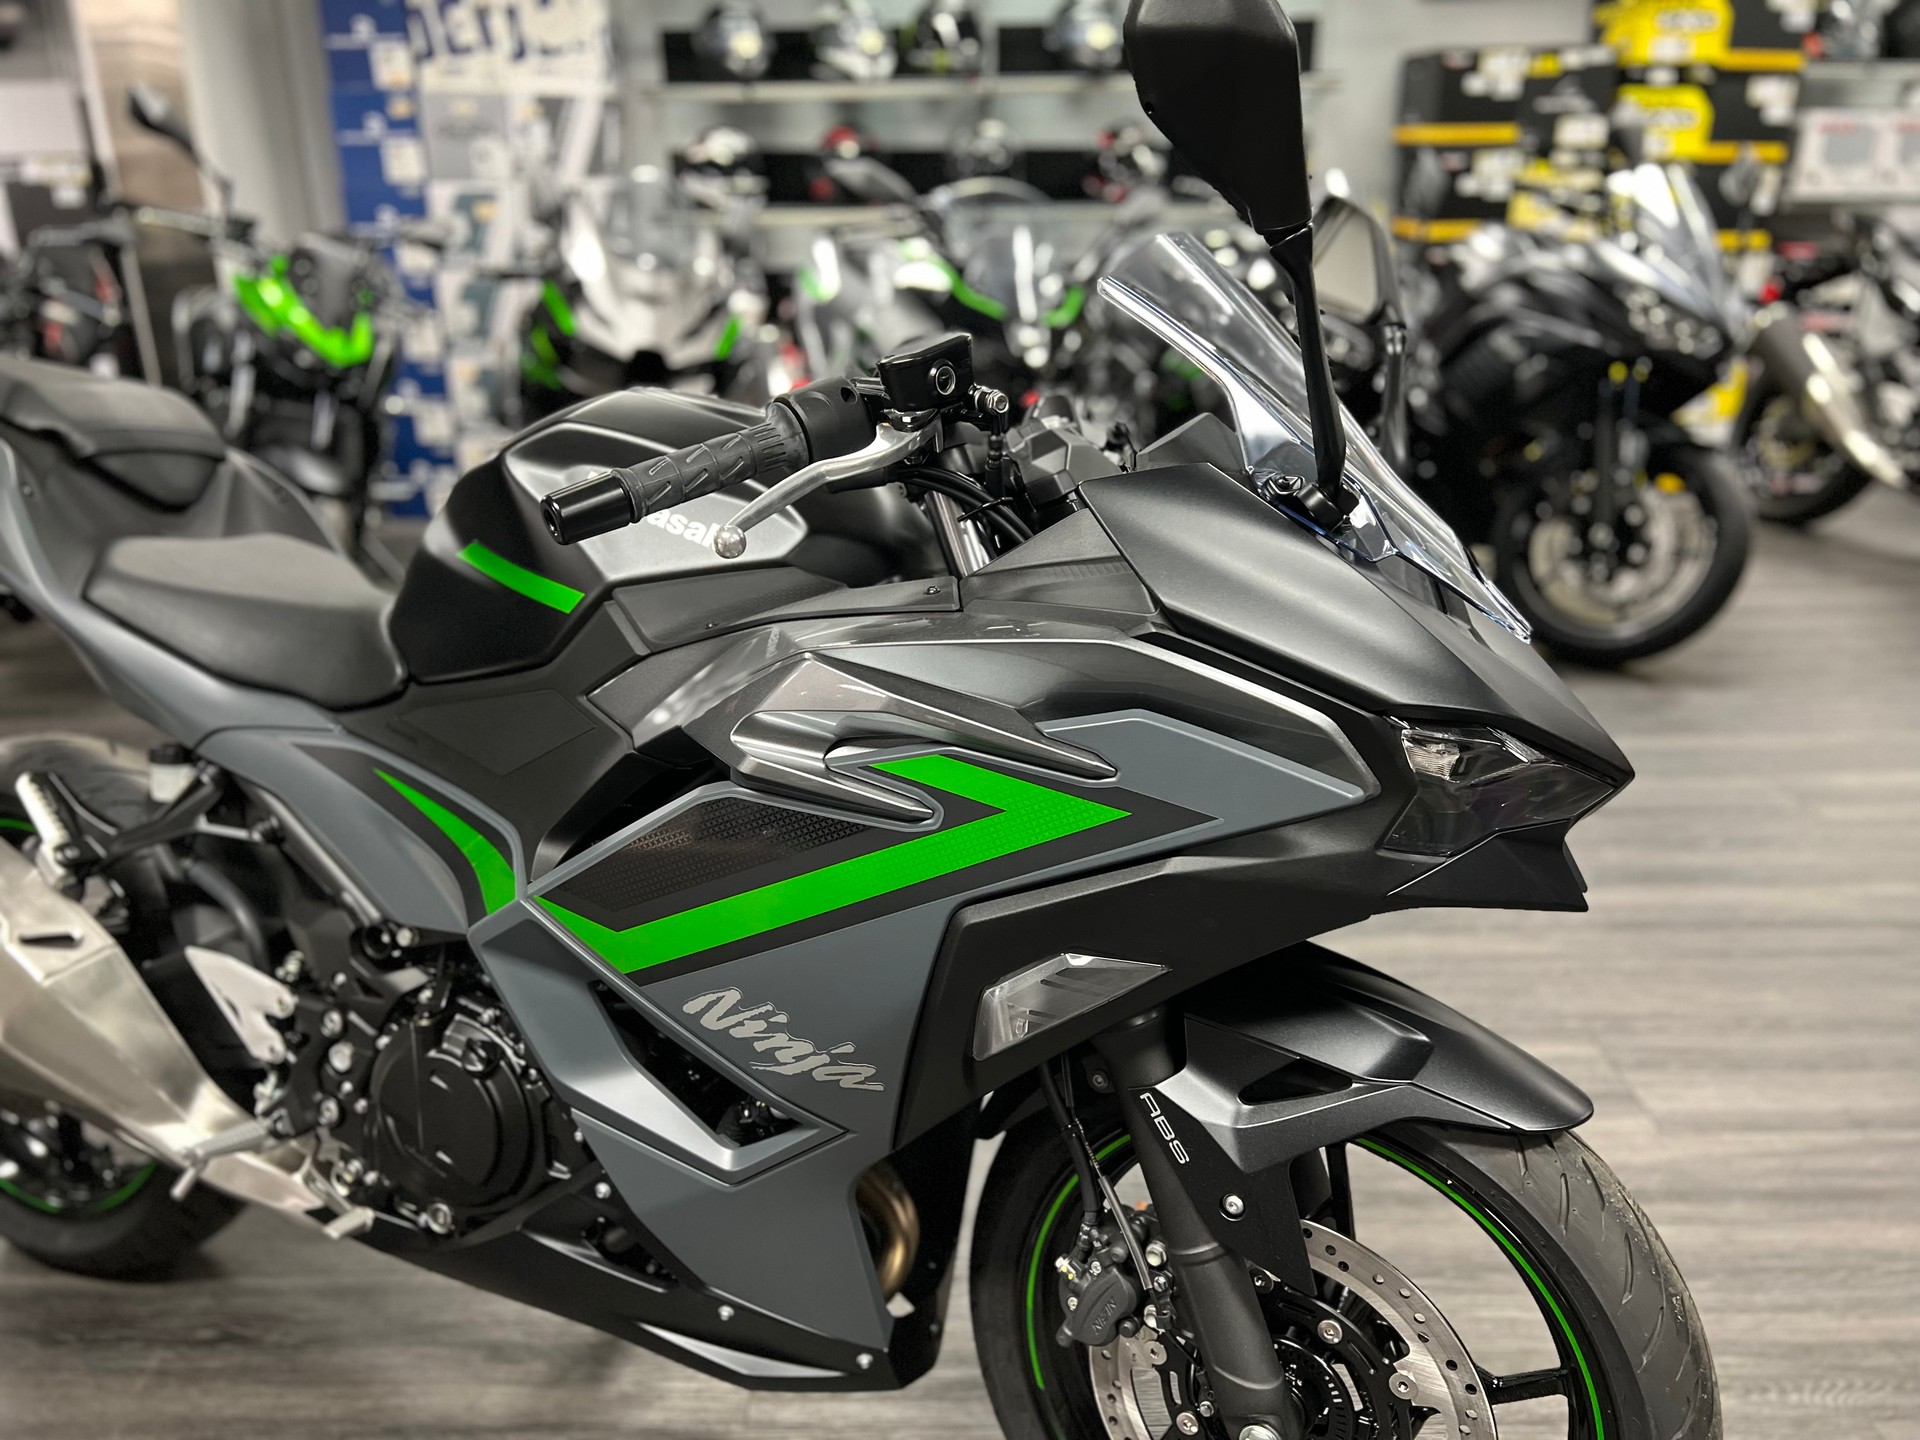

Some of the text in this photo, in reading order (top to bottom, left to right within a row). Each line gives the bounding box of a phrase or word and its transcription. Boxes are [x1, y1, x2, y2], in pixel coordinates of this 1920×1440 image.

[646, 509, 722, 548] asak
[682, 987, 885, 1091] Ninja
[1140, 1092, 1190, 1164] ABS
